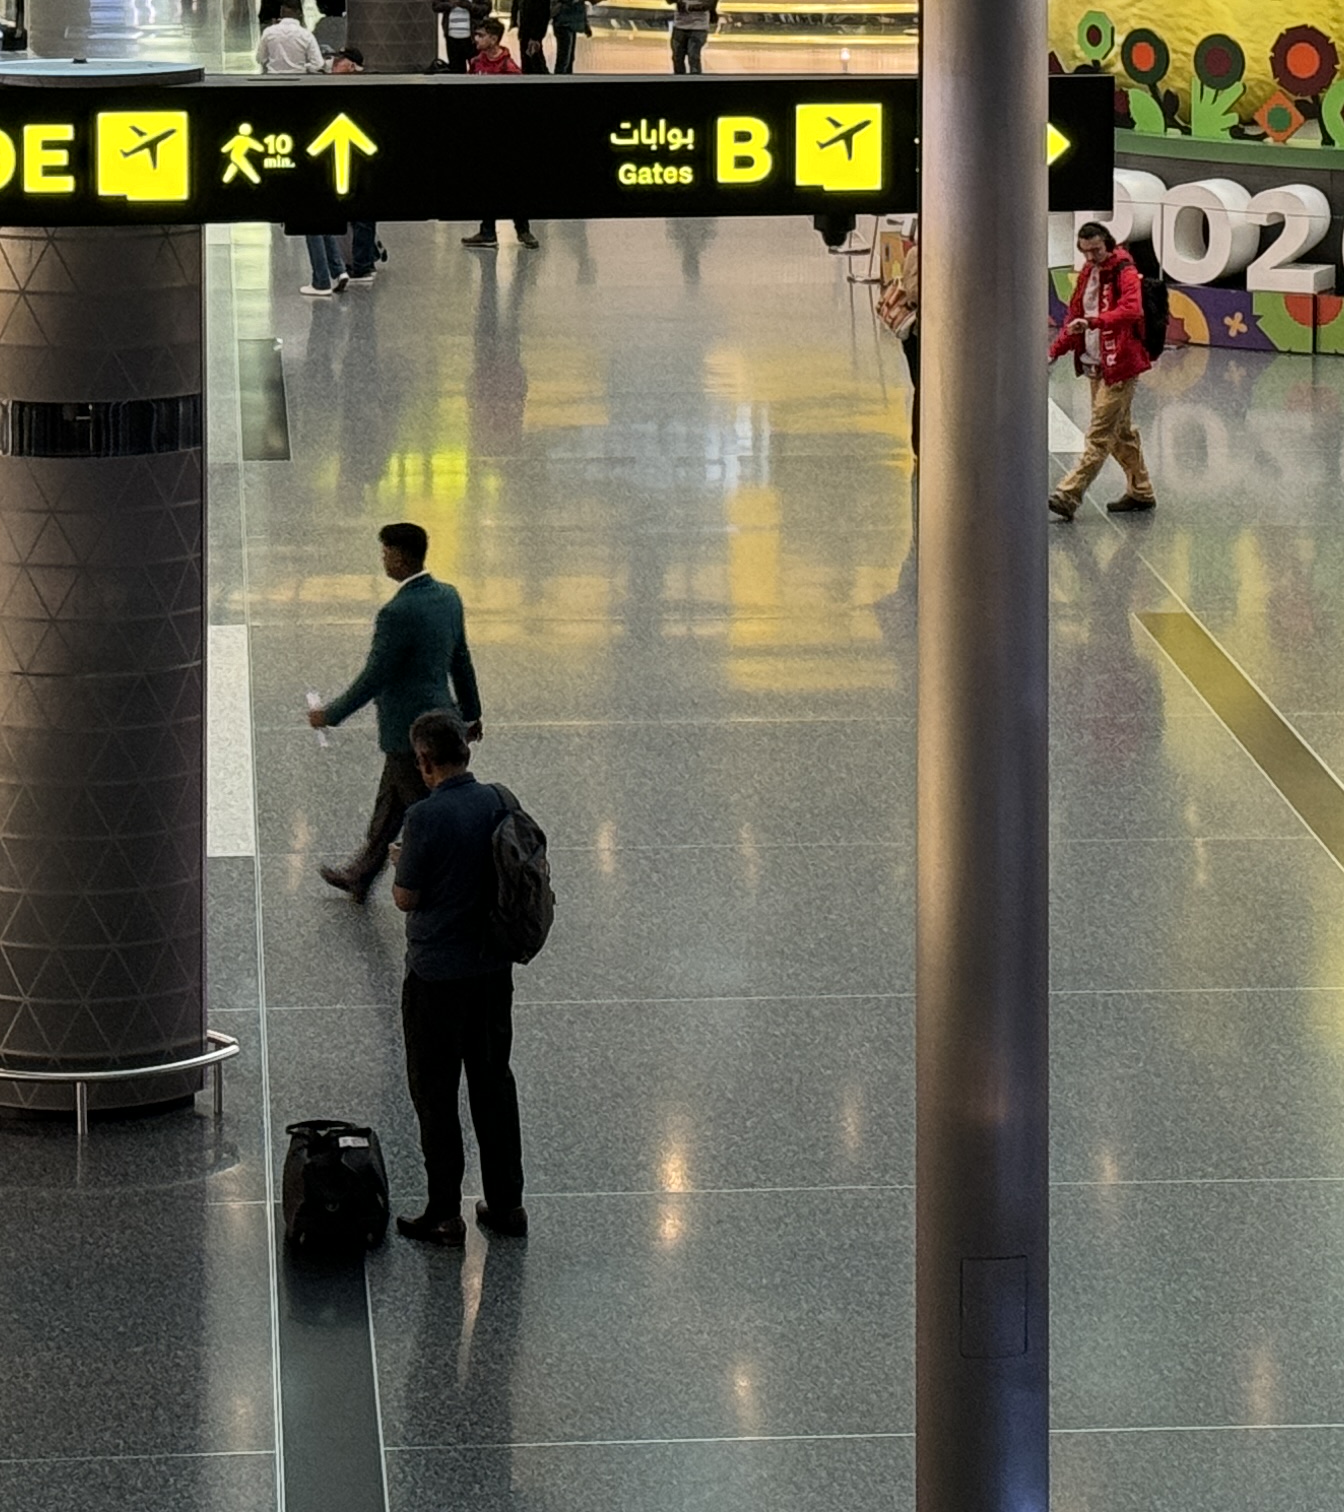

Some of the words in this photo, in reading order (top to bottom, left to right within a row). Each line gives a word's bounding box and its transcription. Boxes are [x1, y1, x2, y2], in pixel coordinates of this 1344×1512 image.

[263, 133, 294, 156] 10
[609, 118, 695, 152] بوابات
[716, 115, 774, 184] B
[262, 155, 296, 170] min.
[617, 163, 694, 187] Gates
